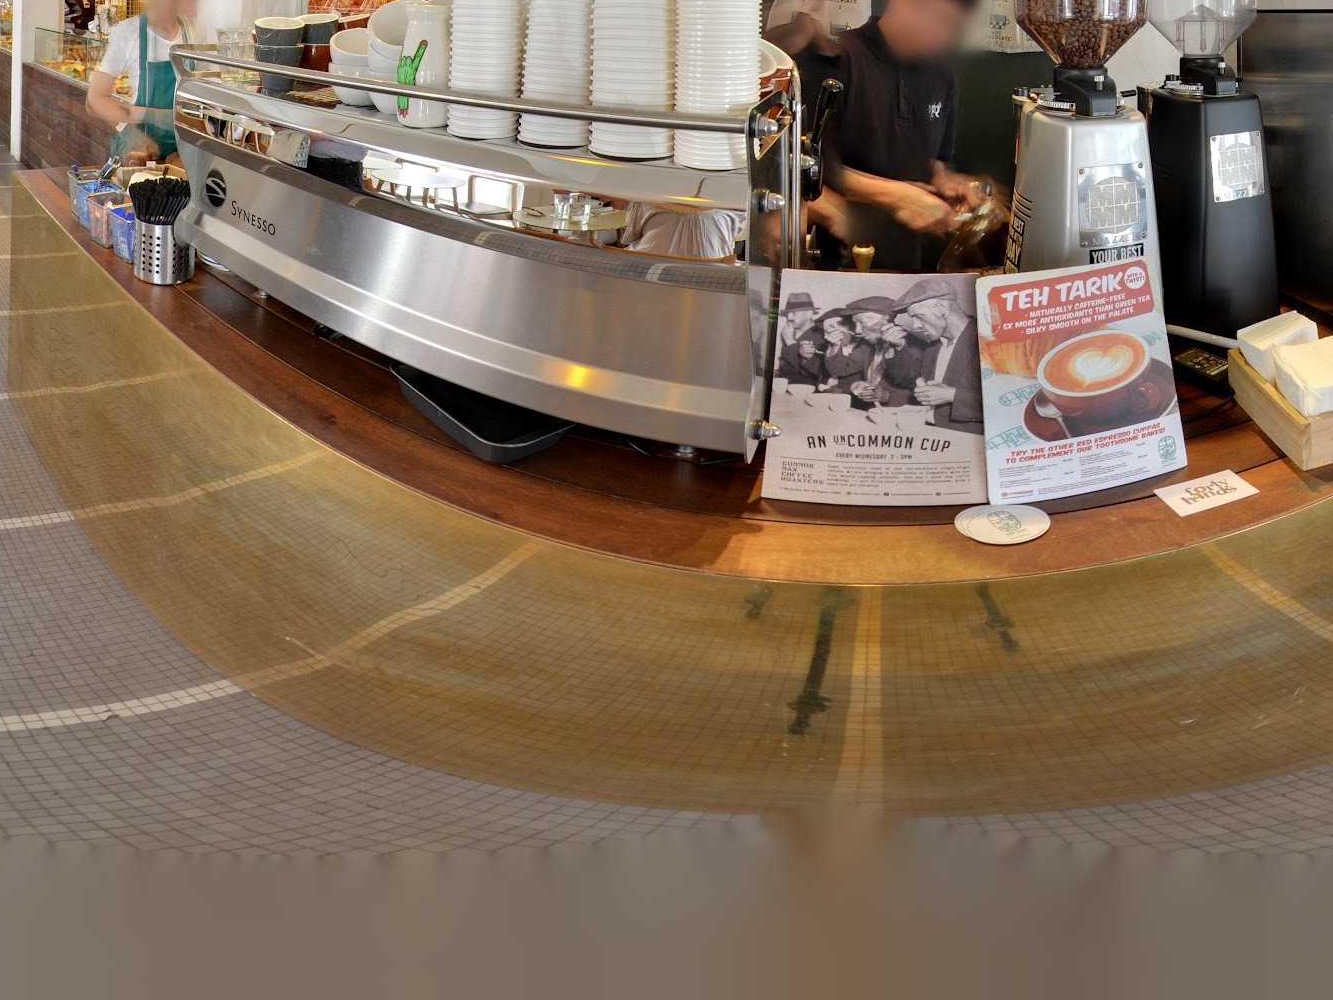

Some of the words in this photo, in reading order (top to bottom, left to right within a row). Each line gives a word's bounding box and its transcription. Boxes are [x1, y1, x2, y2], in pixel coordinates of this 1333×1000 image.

[231, 200, 276, 235] SYNESSO
[1092, 249, 1118, 264] YOUR
[1120, 245, 1142, 262] BEST
[1001, 286, 1050, 312] TEH
[1055, 271, 1123, 302] TARIK
[1126, 276, 1145, 284] TWIST!
[1015, 320, 1037, 329] MORE
[1039, 308, 1093, 325] ANTIOXIDANTS
[1095, 303, 1113, 314] THAN
[1115, 299, 1136, 309] GREEN
[1138, 295, 1151, 304] TEA
[1029, 304, 1072, 318] NATURALLY
[1074, 293, 1126, 310] CAFFEINE-FREE
[1025, 325, 1046, 335] SILKY
[1049, 320, 1079, 331] SMOOTH
[1094, 314, 1107, 322] THE
[1109, 308, 1134, 319] PALATE
[807, 435, 827, 449] AN
[921, 438, 951, 453] CUP
[1019, 449, 1074, 462] COMPLEMENT
[1077, 445, 1093, 454] OUR
[1096, 434, 1140, 450] TOOTHSOME
[1141, 427, 1166, 440] BAKES!
[1048, 442, 1074, 452] OTHER
[1077, 439, 1092, 447] RED
[1094, 431, 1131, 444] ESPRESSO
[1133, 423, 1161, 434] CUPPAS
[1185, 479, 1228, 496] forty
